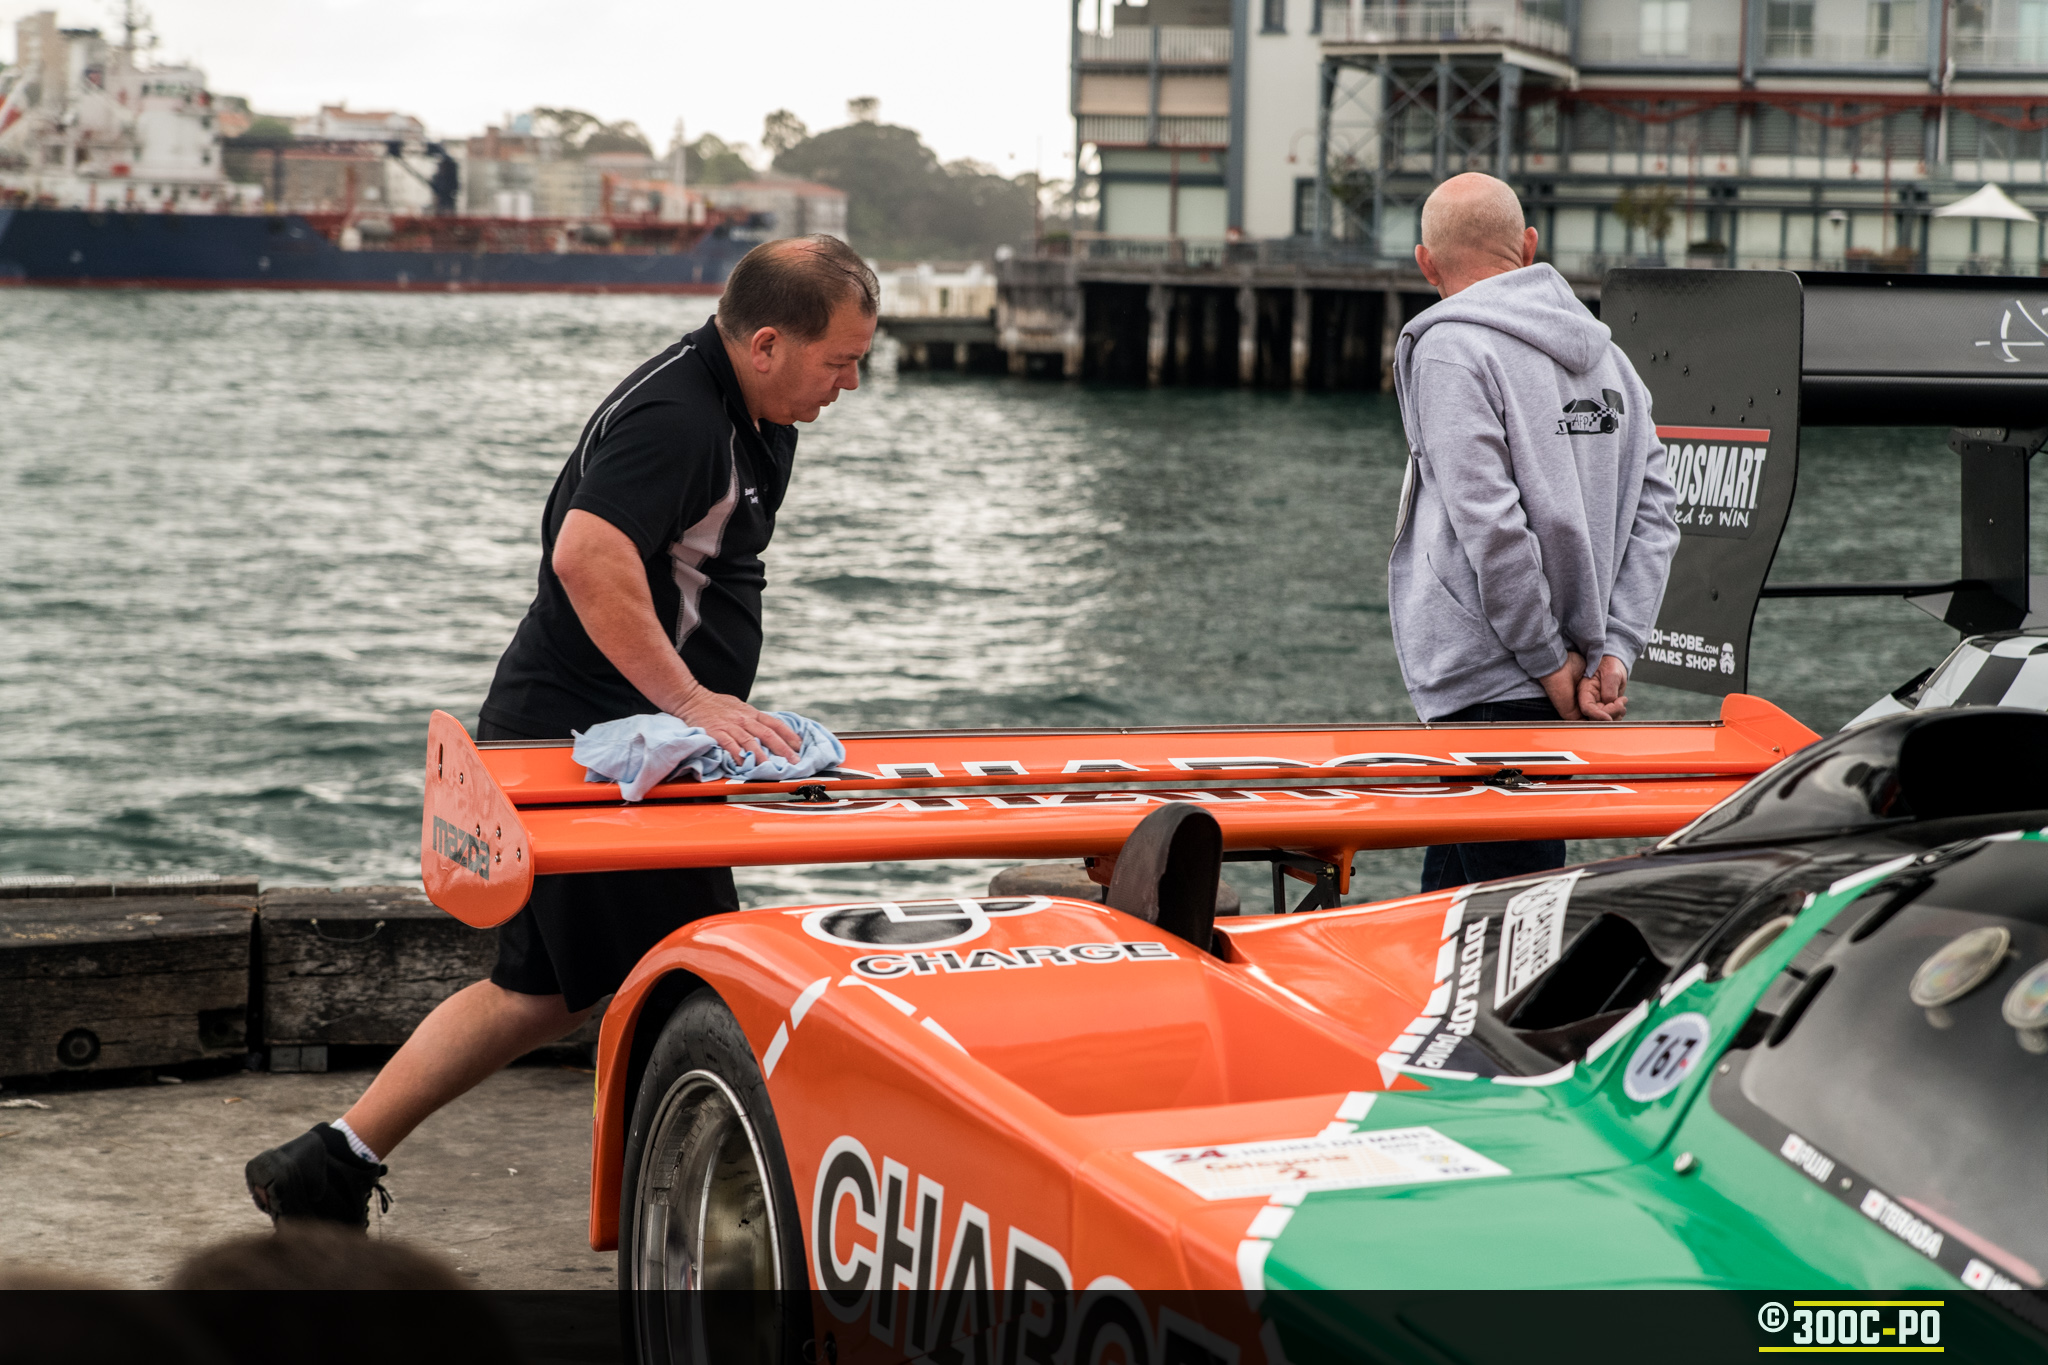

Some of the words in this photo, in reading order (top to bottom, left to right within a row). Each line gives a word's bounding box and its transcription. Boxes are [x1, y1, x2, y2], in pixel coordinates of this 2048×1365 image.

[1661, 443, 1767, 510] BOSMART
[1698, 506, 1714, 526] to
[1719, 508, 1750, 529] WIN
[1648, 646, 1683, 666] WARS
[1685, 653, 1717, 672] SHOP
[1649, 628, 1719, 655] DI-ROBE.COM
[851, 941, 1180, 980] CHARGE
[1514, 927, 1532, 971] CLUB
[1446, 916, 1490, 1037] DUNLOP
